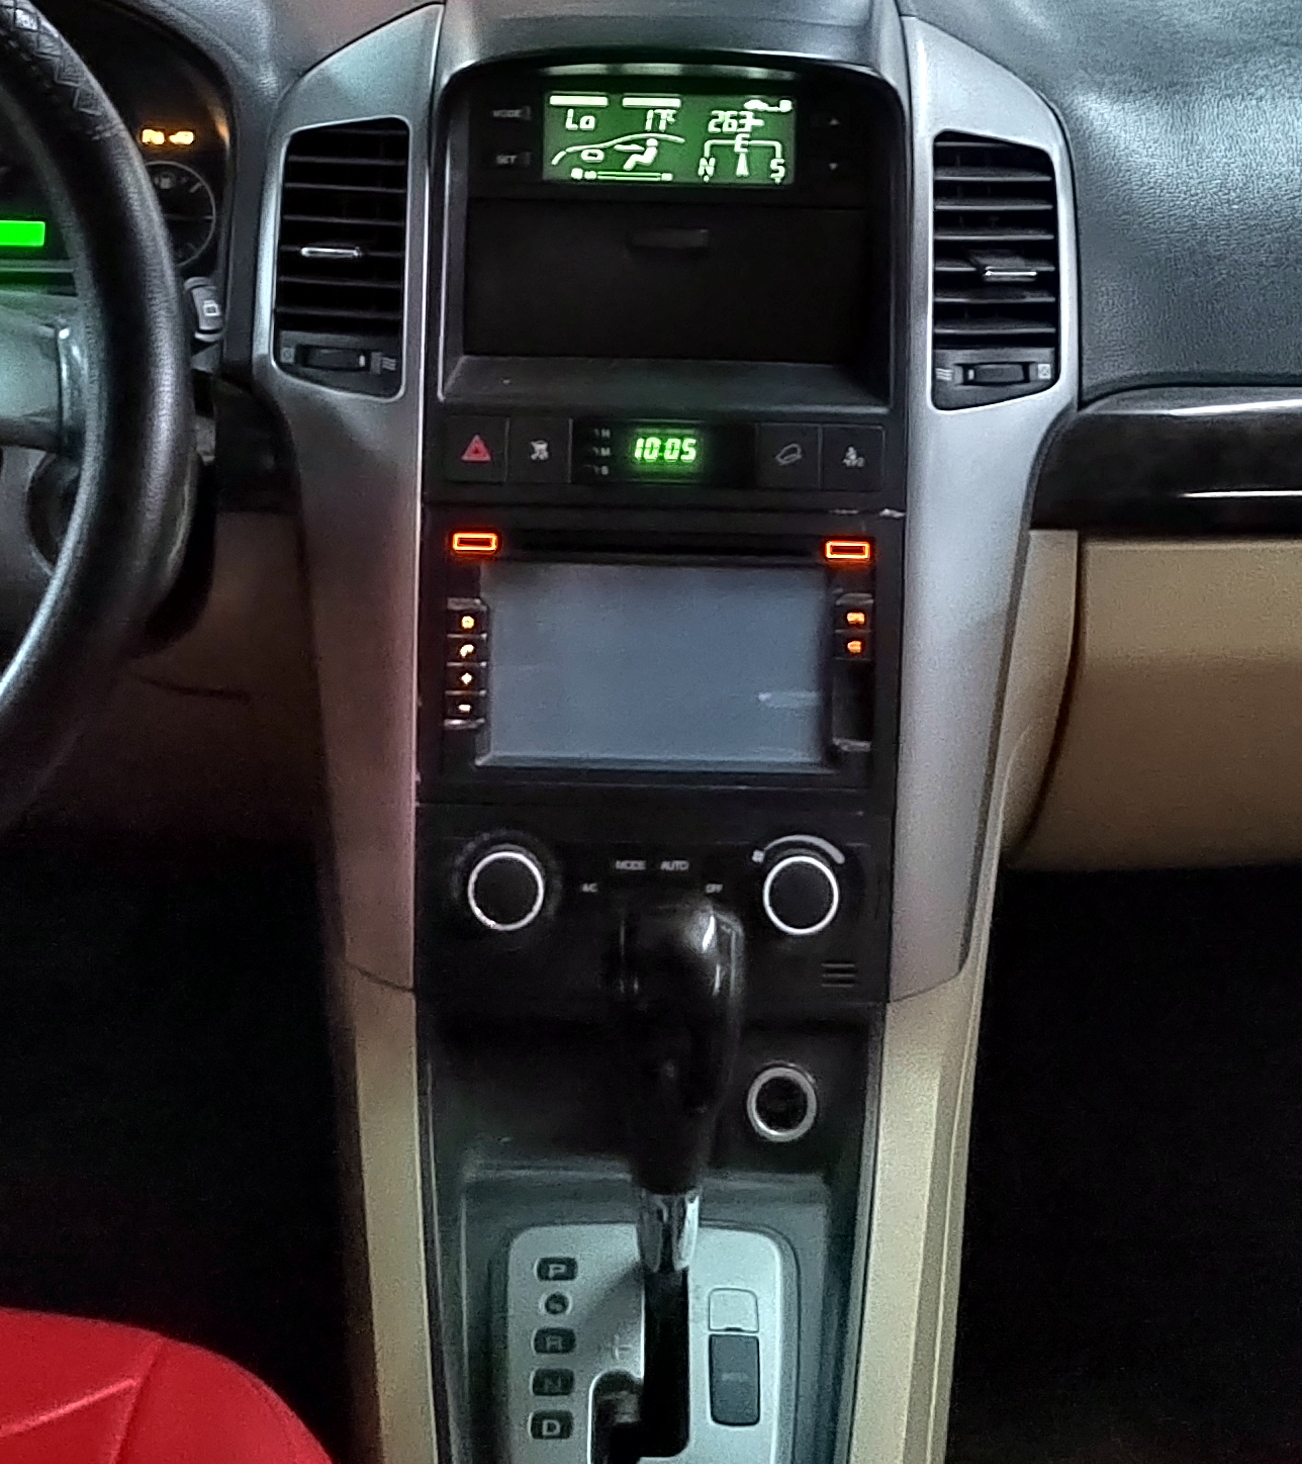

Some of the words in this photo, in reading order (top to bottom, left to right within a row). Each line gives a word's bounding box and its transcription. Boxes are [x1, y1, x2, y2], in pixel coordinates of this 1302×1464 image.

[635, 437, 697, 463] 10:05
[615, 859, 647, 871] MODE
[660, 859, 690, 871] AUTO
[549, 1263, 567, 1277] P
[542, 1419, 561, 1436] D
